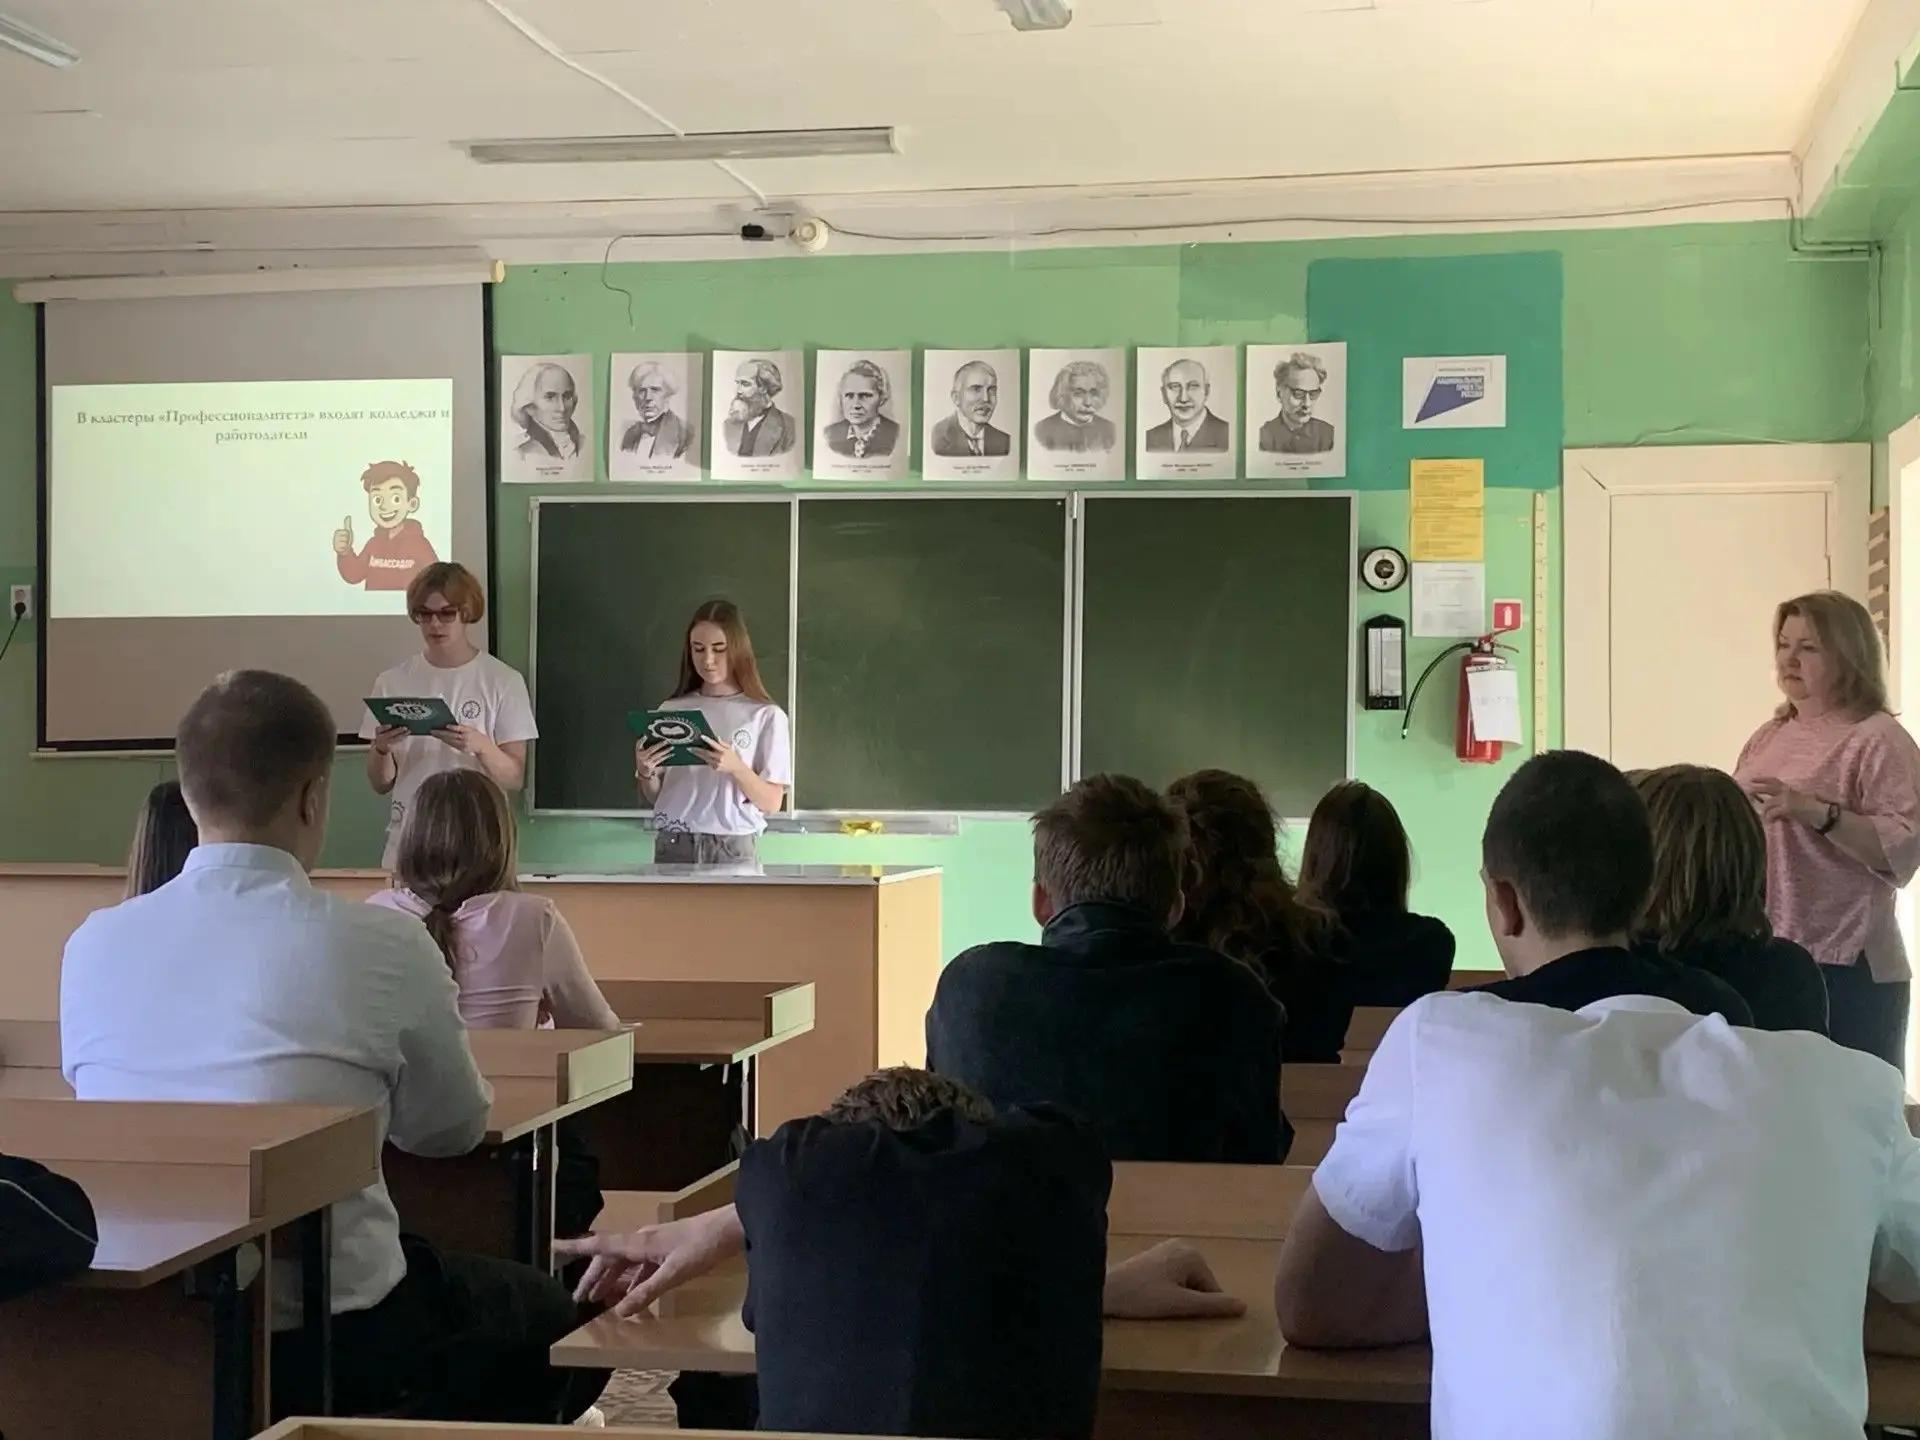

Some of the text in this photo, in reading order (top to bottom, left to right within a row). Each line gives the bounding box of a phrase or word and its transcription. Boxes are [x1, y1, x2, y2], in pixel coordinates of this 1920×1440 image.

[76, 409, 451, 426] В кластеры «Профессионалитета» входят колледжи и
[215, 429, 308, 444] работодатели
